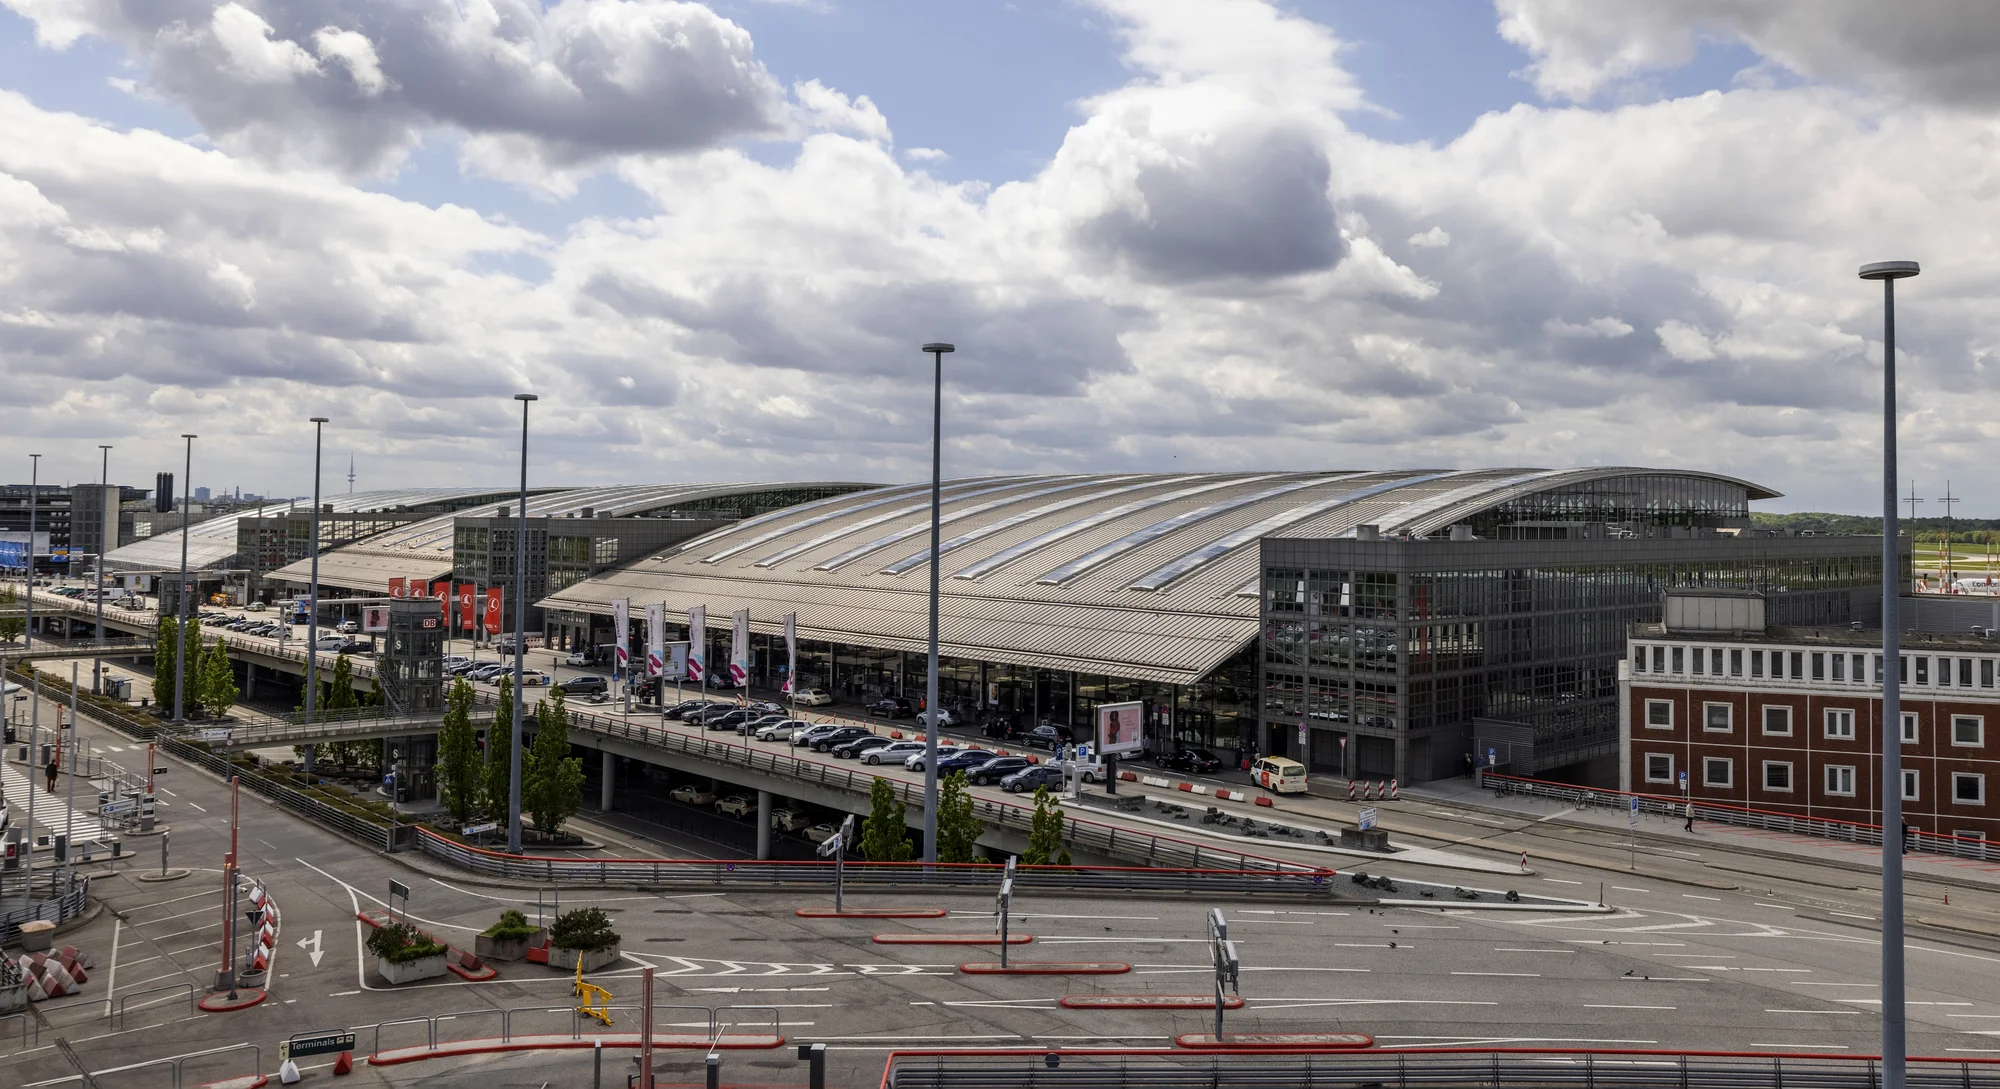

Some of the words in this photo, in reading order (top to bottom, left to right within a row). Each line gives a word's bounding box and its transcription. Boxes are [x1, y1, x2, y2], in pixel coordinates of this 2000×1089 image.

[1972, 580, 1998, 588] Conor
[424, 619, 436, 627] DB
[395, 640, 402, 649] S
[392, 748, 399, 758] S
[291, 1038, 336, 1050] Terminals
